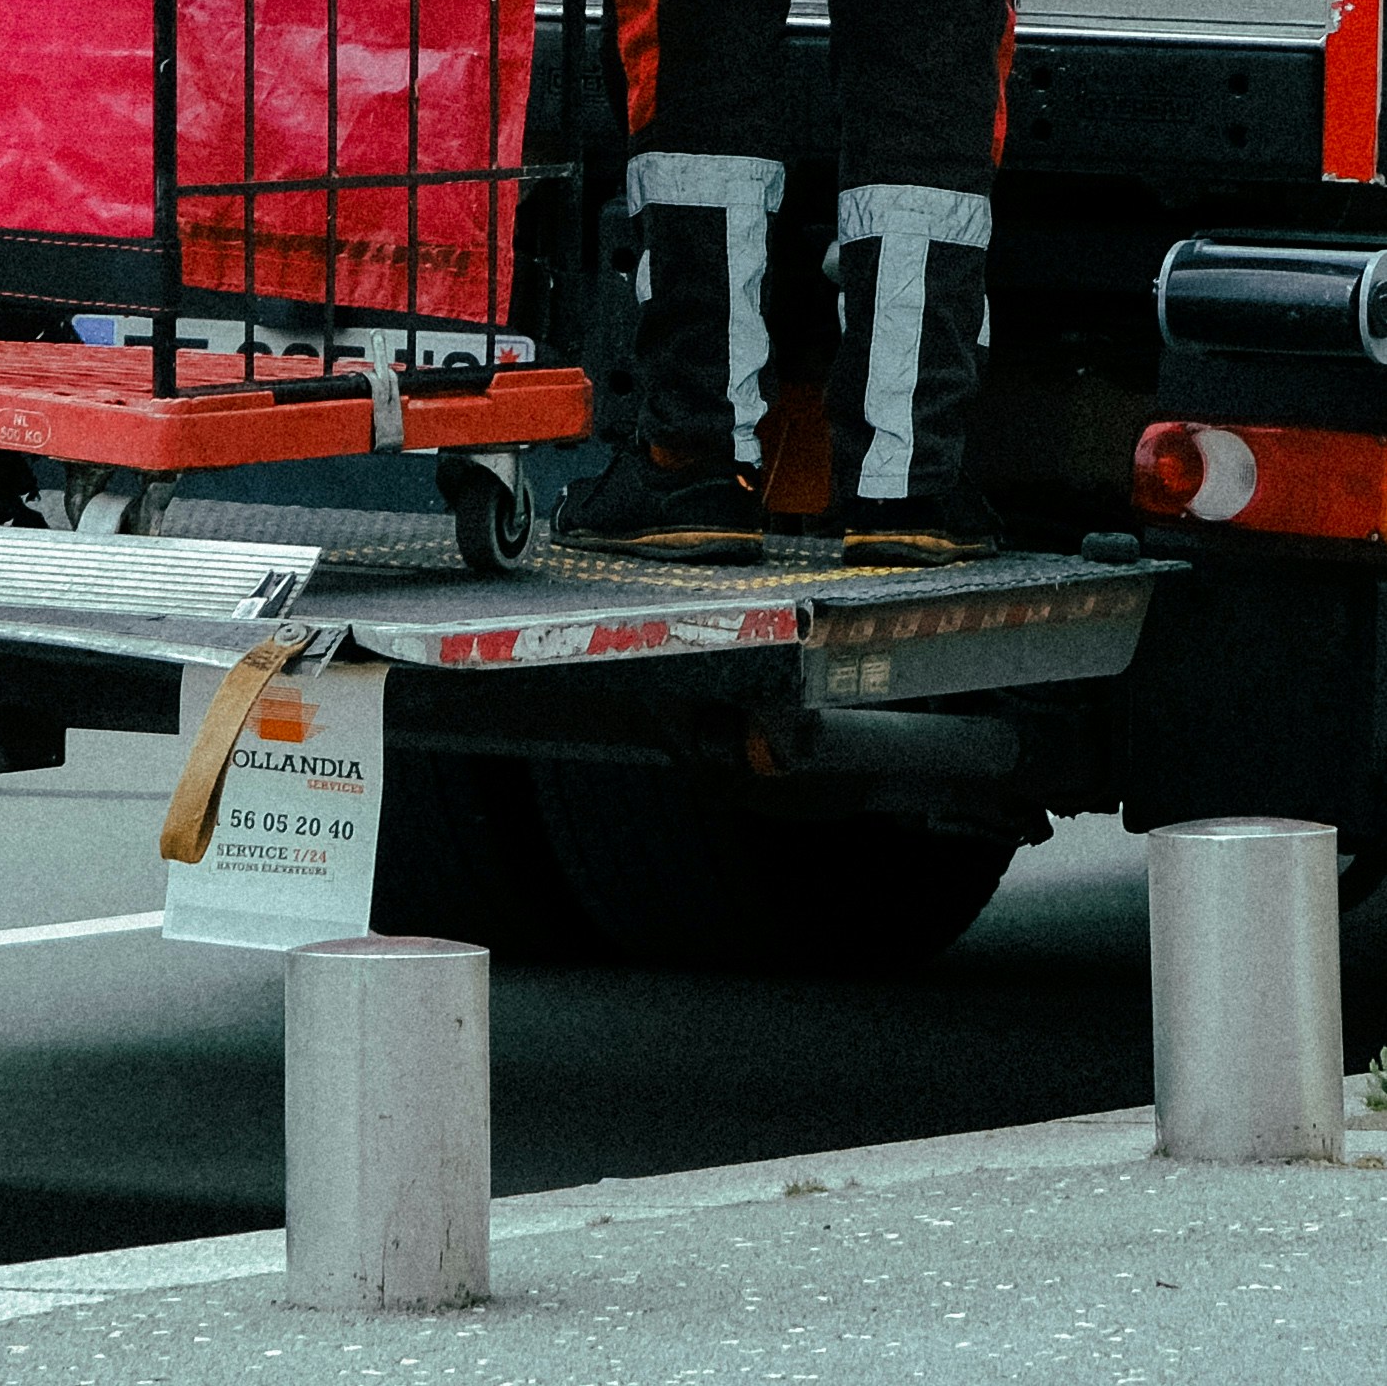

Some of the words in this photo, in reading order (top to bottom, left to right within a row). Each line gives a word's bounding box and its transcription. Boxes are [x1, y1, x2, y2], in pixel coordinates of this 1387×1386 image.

[13, 413, 29, 428] NL
[0, 425, 20, 441] 500
[24, 429, 42, 444] KG
[230, 749, 364, 780] OLLANDIA
[307, 778, 364, 794] SERVICES
[230, 809, 256, 830] 56
[262, 812, 288, 833] 05
[295, 816, 321, 837] 20
[328, 819, 354, 840] 40
[216, 843, 288, 859] SERVICE
[293, 848, 327, 863] 7/24
